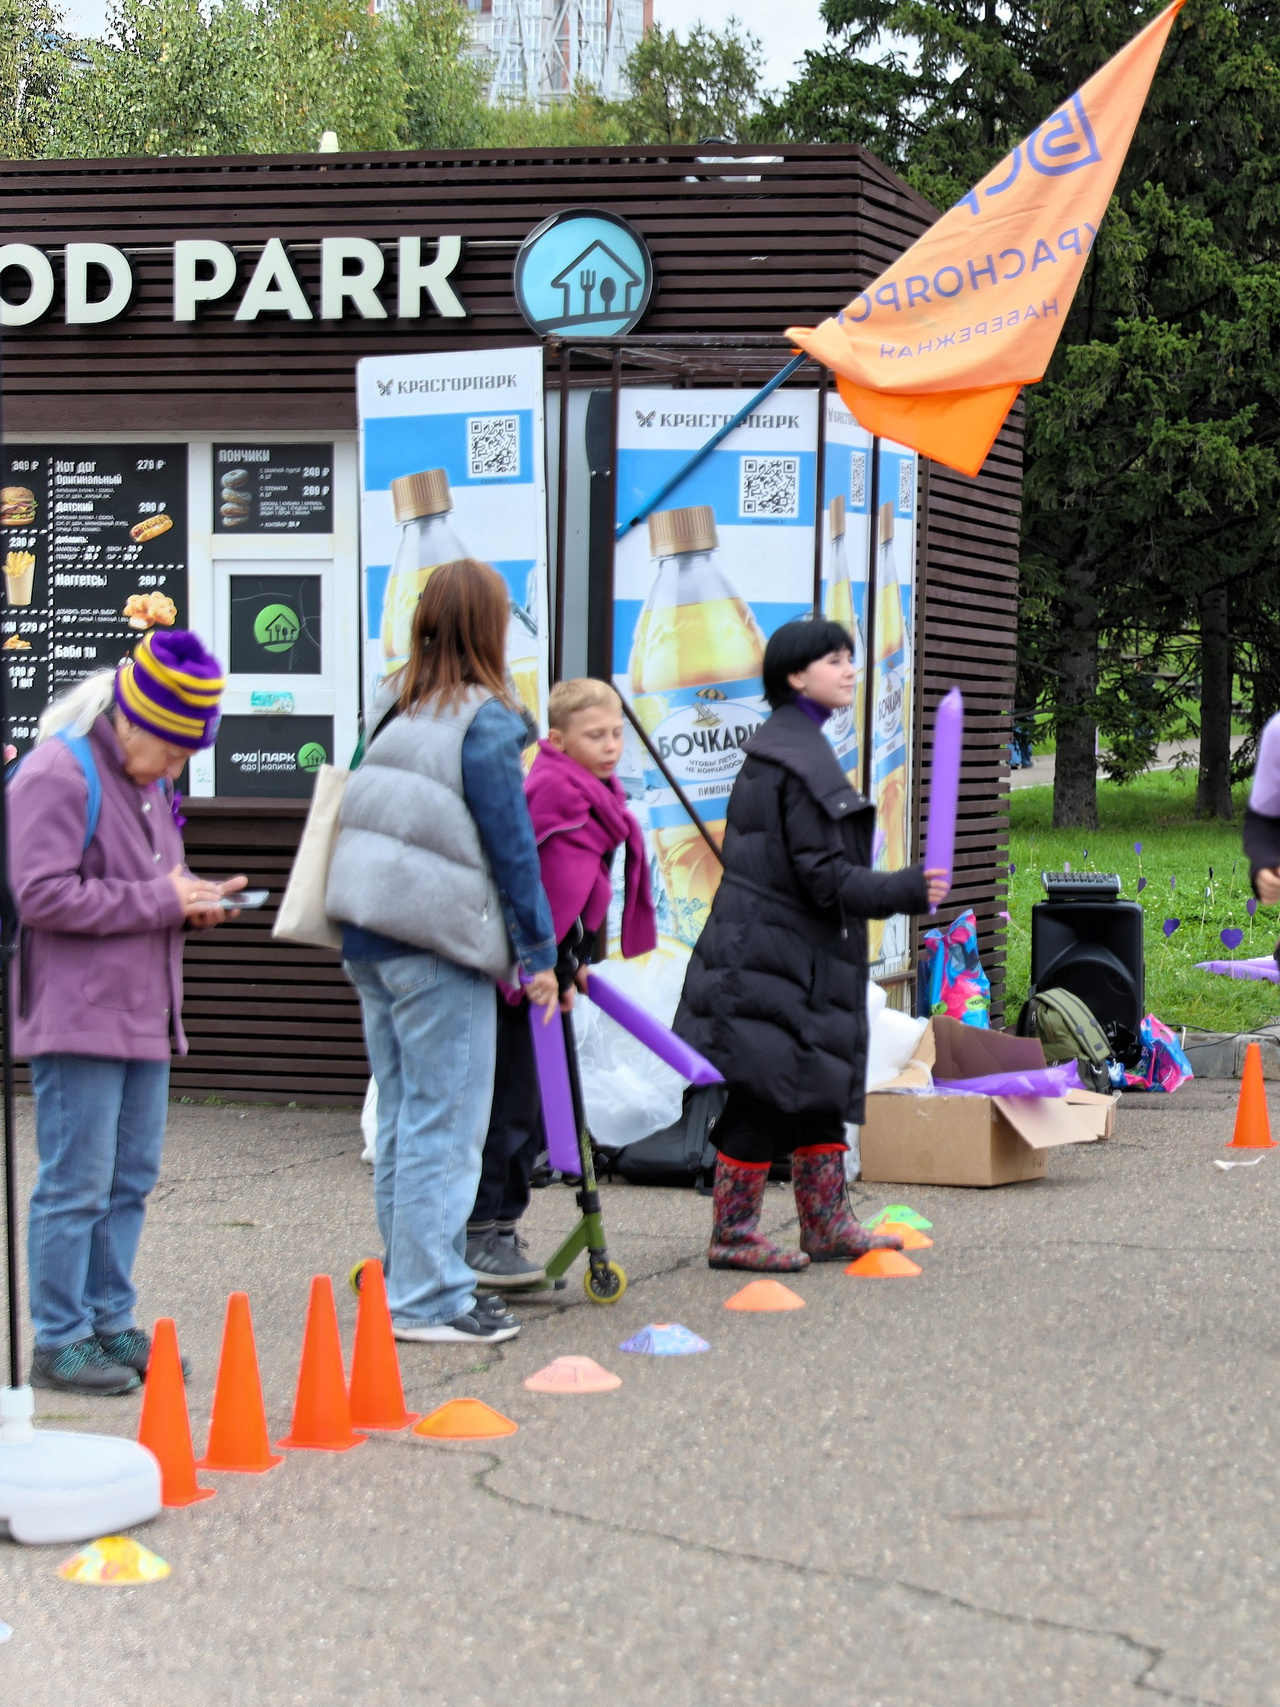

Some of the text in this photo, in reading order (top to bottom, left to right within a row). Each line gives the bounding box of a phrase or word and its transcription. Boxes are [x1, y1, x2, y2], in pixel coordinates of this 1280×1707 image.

[172, 235, 468, 322] PARK
[219, 450, 271, 462] ПОНЧИКИ
[55, 460, 75, 473] Хот
[76, 461, 97, 474] дог
[136, 459, 154, 472] 279
[302, 467, 321, 478] 249
[55, 474, 122, 486] Оригинальный
[302, 485, 321, 496] 269
[55, 501, 94, 513] Датский
[138, 502, 156, 513] 290
[55, 574, 107, 587] Наггетсы
[54, 645, 97, 659] Бабл ти
[11, 727, 29, 738] 150
[231, 752, 296, 763] ФУД ПАРК
[689, 752, 738, 767] ЧТОБЫ ЛЕТО
[697, 758, 744, 774] КОНЧАЛОСЬ
[698, 783, 735, 797] ЛИМОНА
